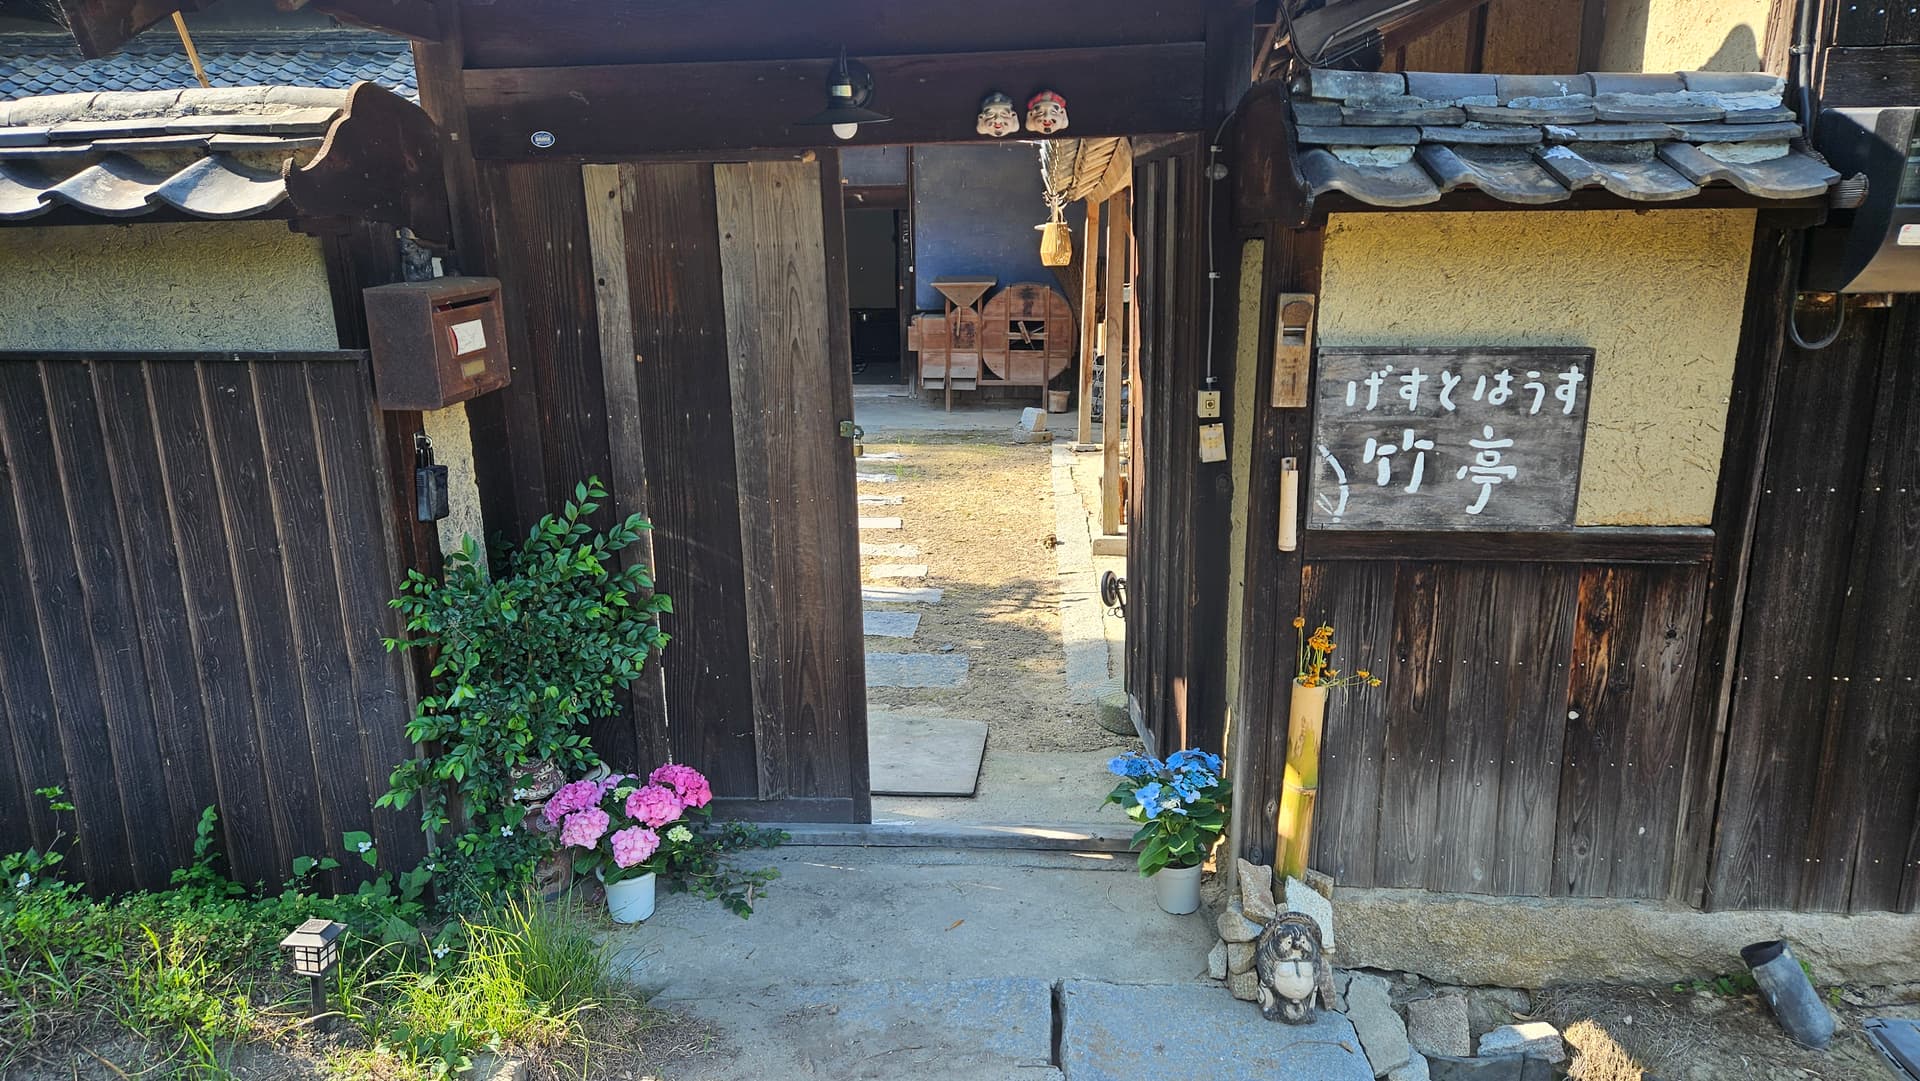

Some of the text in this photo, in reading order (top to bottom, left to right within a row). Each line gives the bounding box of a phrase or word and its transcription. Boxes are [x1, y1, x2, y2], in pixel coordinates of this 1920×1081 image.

[1346, 365, 1584, 414] げすとはうす
[1363, 425, 1517, 514] 竹亭
